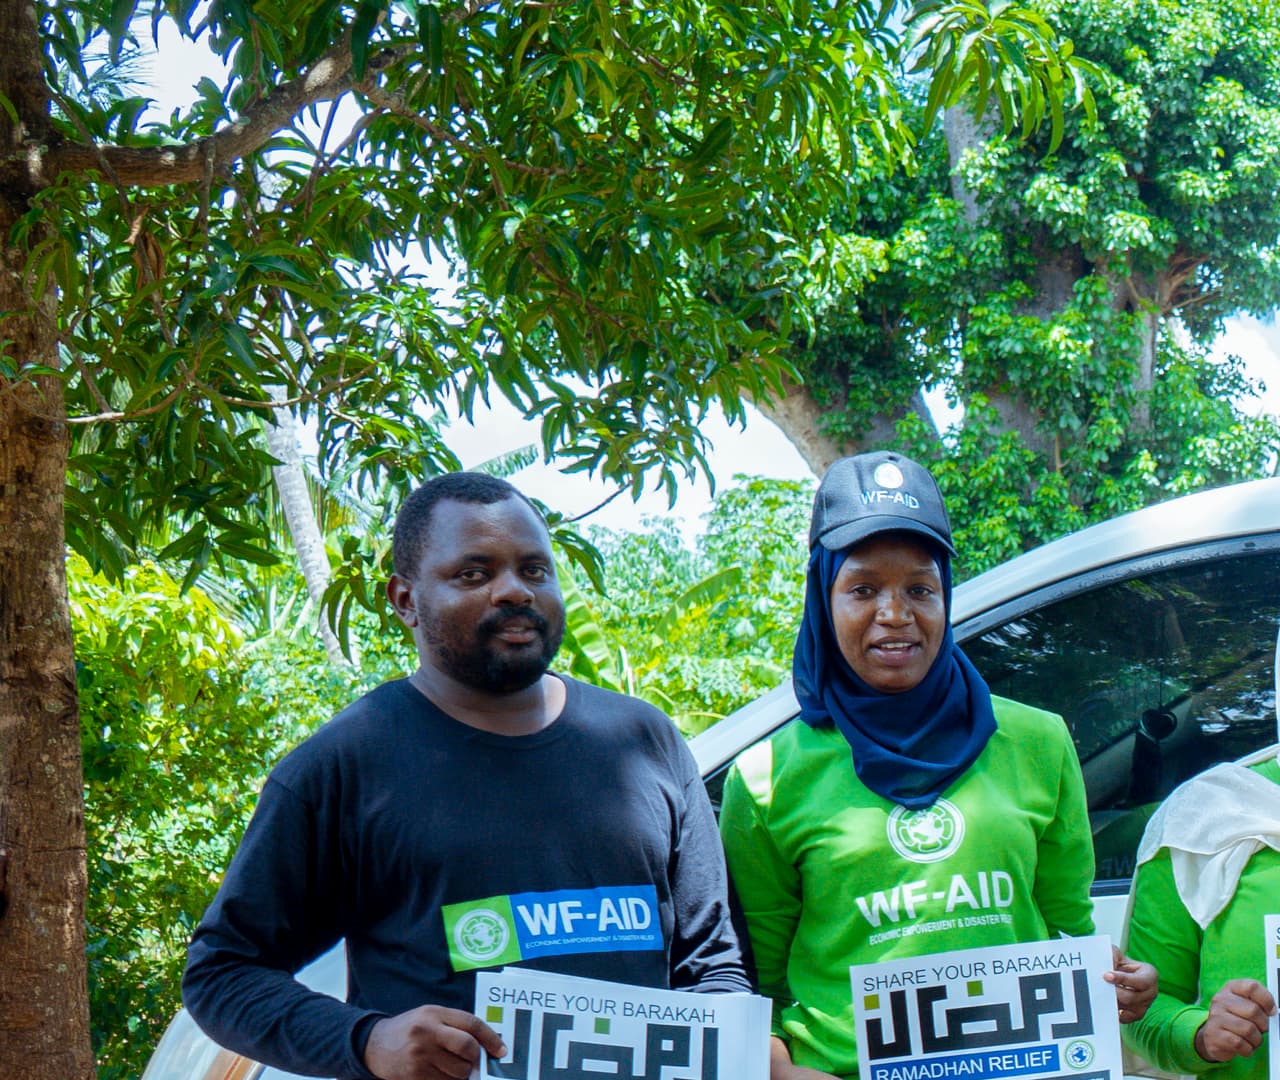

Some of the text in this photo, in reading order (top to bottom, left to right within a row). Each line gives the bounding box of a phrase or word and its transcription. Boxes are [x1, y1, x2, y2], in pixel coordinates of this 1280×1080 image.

[860, 490, 920, 509] WF-AID
[517, 898, 651, 936] WF-AID
[856, 871, 1014, 928] WF-AID
[864, 952, 1082, 992] SHARE YOUR BARAKAH
[488, 986, 716, 1024] SHARE YOUR BARAKAH
[988, 1050, 1052, 1072] RELIEF
